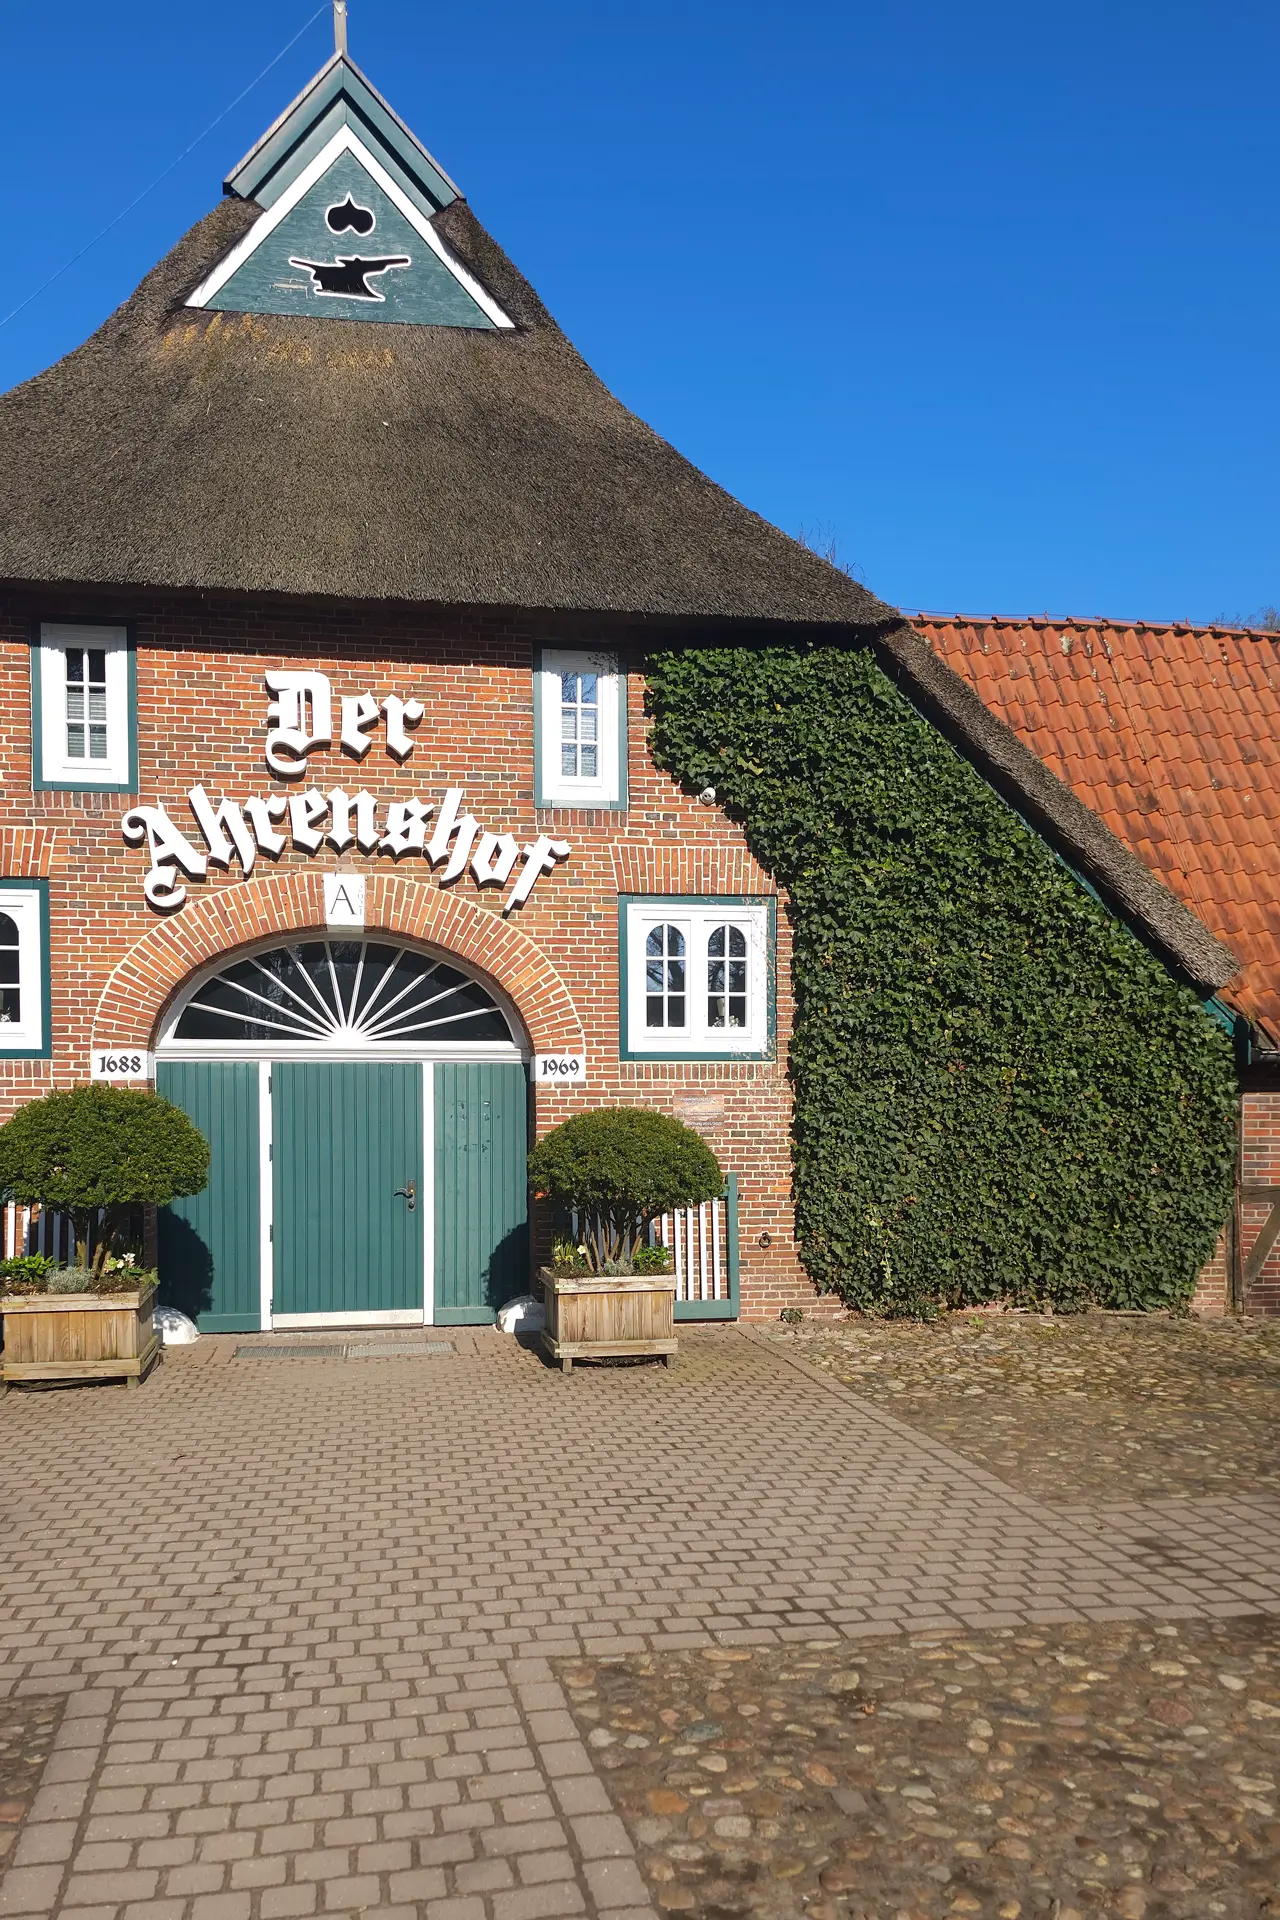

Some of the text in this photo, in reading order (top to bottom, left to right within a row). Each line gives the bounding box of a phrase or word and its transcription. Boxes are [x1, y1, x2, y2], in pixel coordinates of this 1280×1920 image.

[266, 670, 425, 774] Der
[121, 783, 573, 912] Ahrenshof
[329, 884, 357, 915] A
[98, 1055, 142, 1073] 1688
[541, 1058, 580, 1076] 1969
